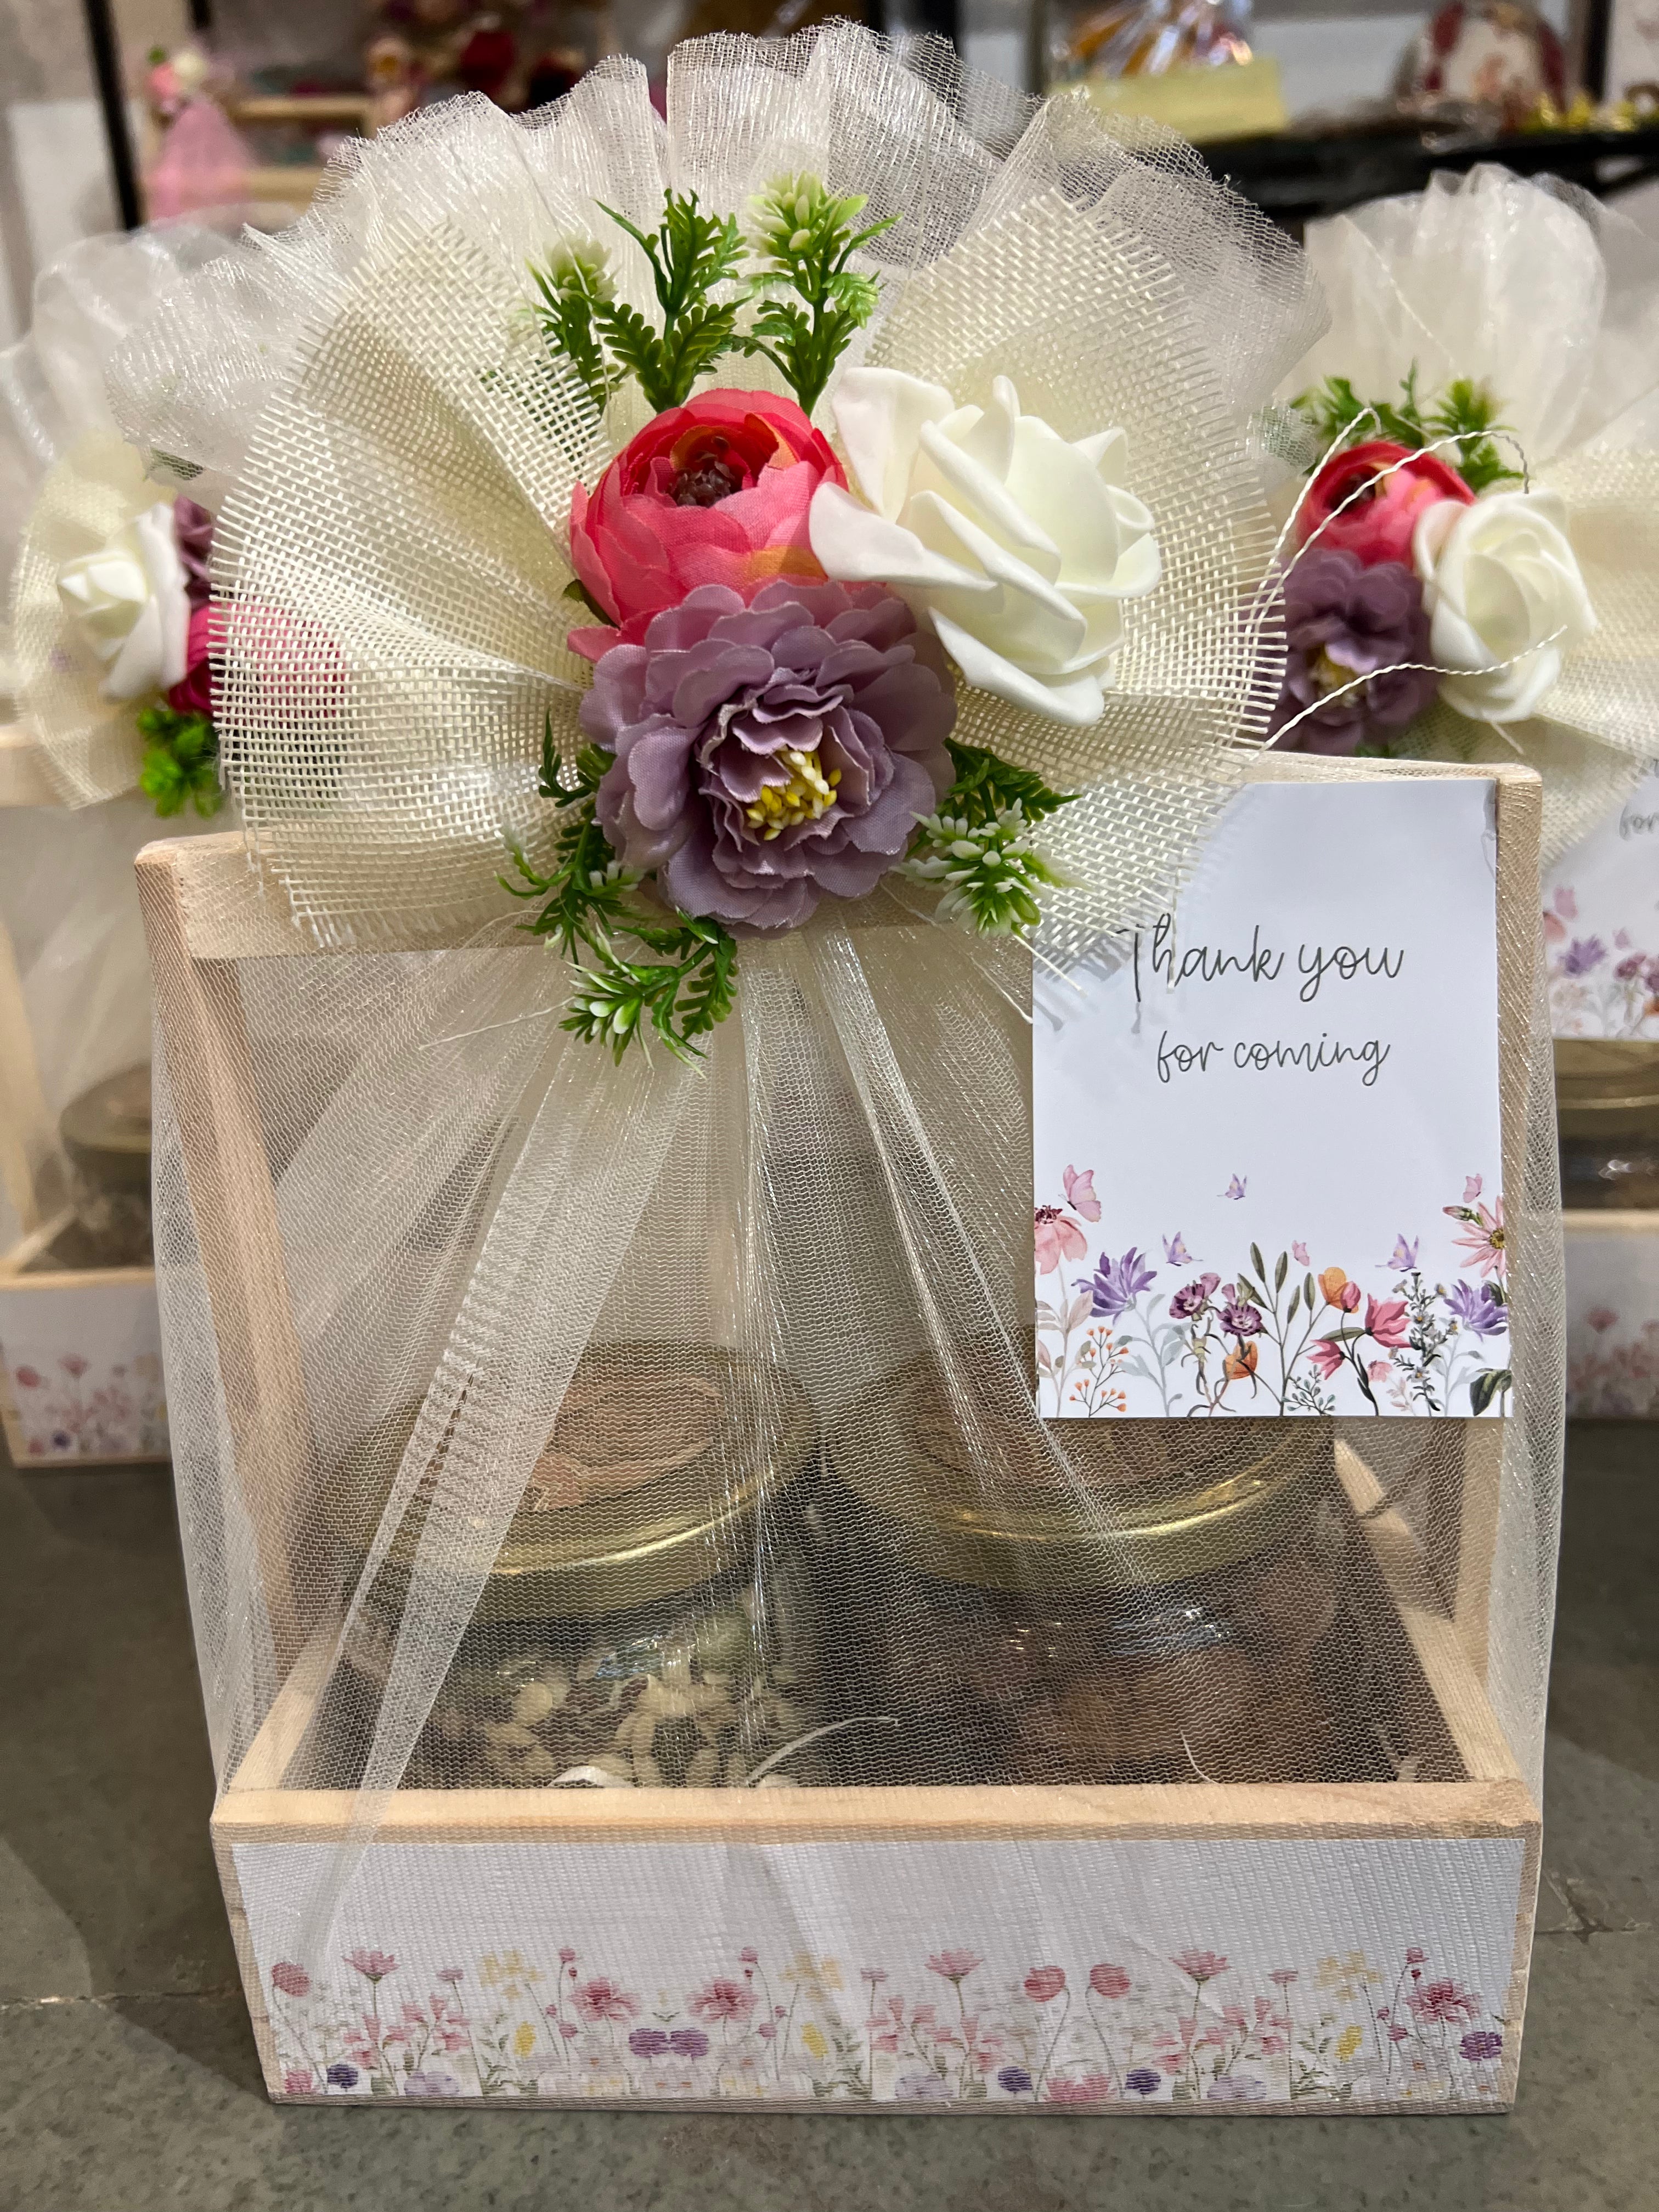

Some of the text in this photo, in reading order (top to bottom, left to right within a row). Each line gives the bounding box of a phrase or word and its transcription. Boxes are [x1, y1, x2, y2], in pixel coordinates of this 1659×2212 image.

[1109, 912, 1405, 1003] Thank you
[1157, 1029, 1391, 1087] for coming
